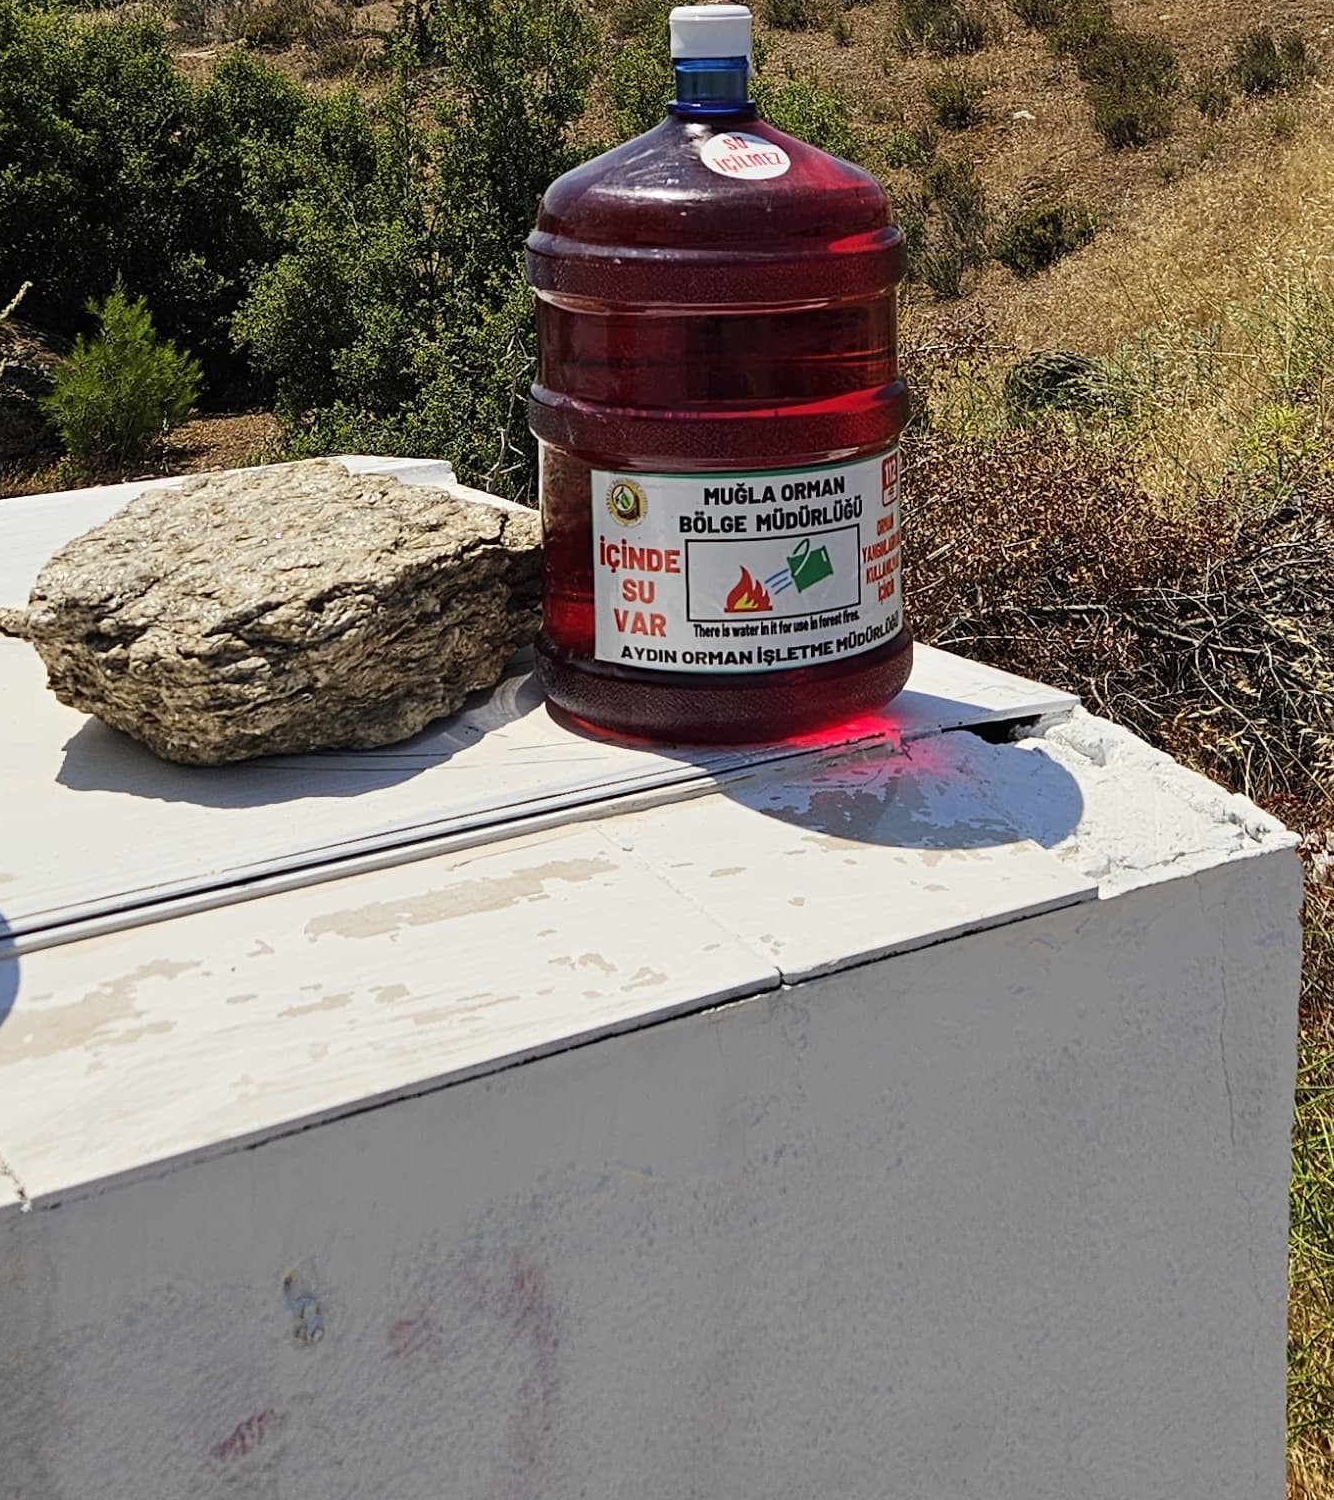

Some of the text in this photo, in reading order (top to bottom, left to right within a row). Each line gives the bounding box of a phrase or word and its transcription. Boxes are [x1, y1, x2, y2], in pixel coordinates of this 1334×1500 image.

[723, 136, 749, 150] SU
[712, 152, 786, 173] İÇİLMEZ
[704, 476, 845, 506] MUĞLA ORMAN
[679, 495, 863, 534] BÖLGE MÜDÜRLÜĞÜ
[599, 534, 681, 573] İÇİNDE
[622, 578, 655, 604] SU
[613, 607, 667, 638] VAR
[693, 609, 860, 638] There is water in it for use in forest fires.
[621, 610, 900, 667] AYDIN ORMAN İŞLETME MÜDÜRLÜĞÜ
